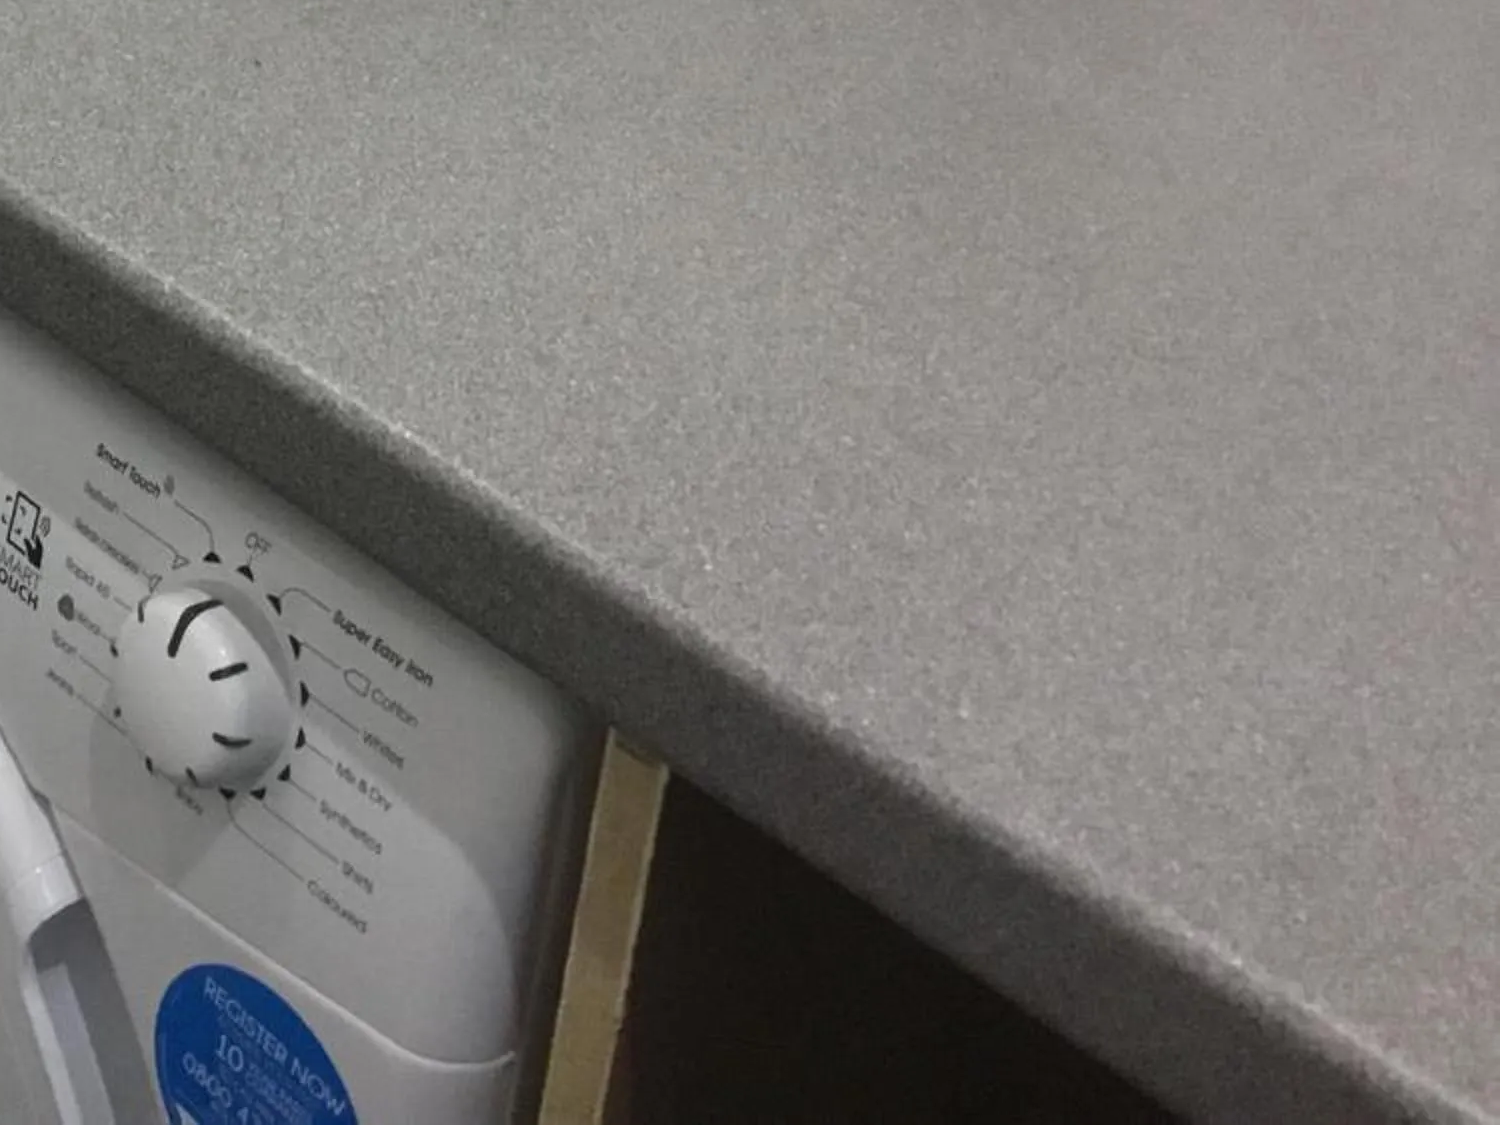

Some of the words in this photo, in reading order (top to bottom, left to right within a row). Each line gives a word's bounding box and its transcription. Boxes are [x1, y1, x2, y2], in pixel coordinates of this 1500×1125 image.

[333, 609, 371, 646] Super
[372, 636, 404, 669] Easy
[404, 660, 433, 688] Iron
[371, 688, 419, 726] Cotton
[204, 976, 289, 1065] REGISTER
[290, 1056, 345, 1116] NOW
